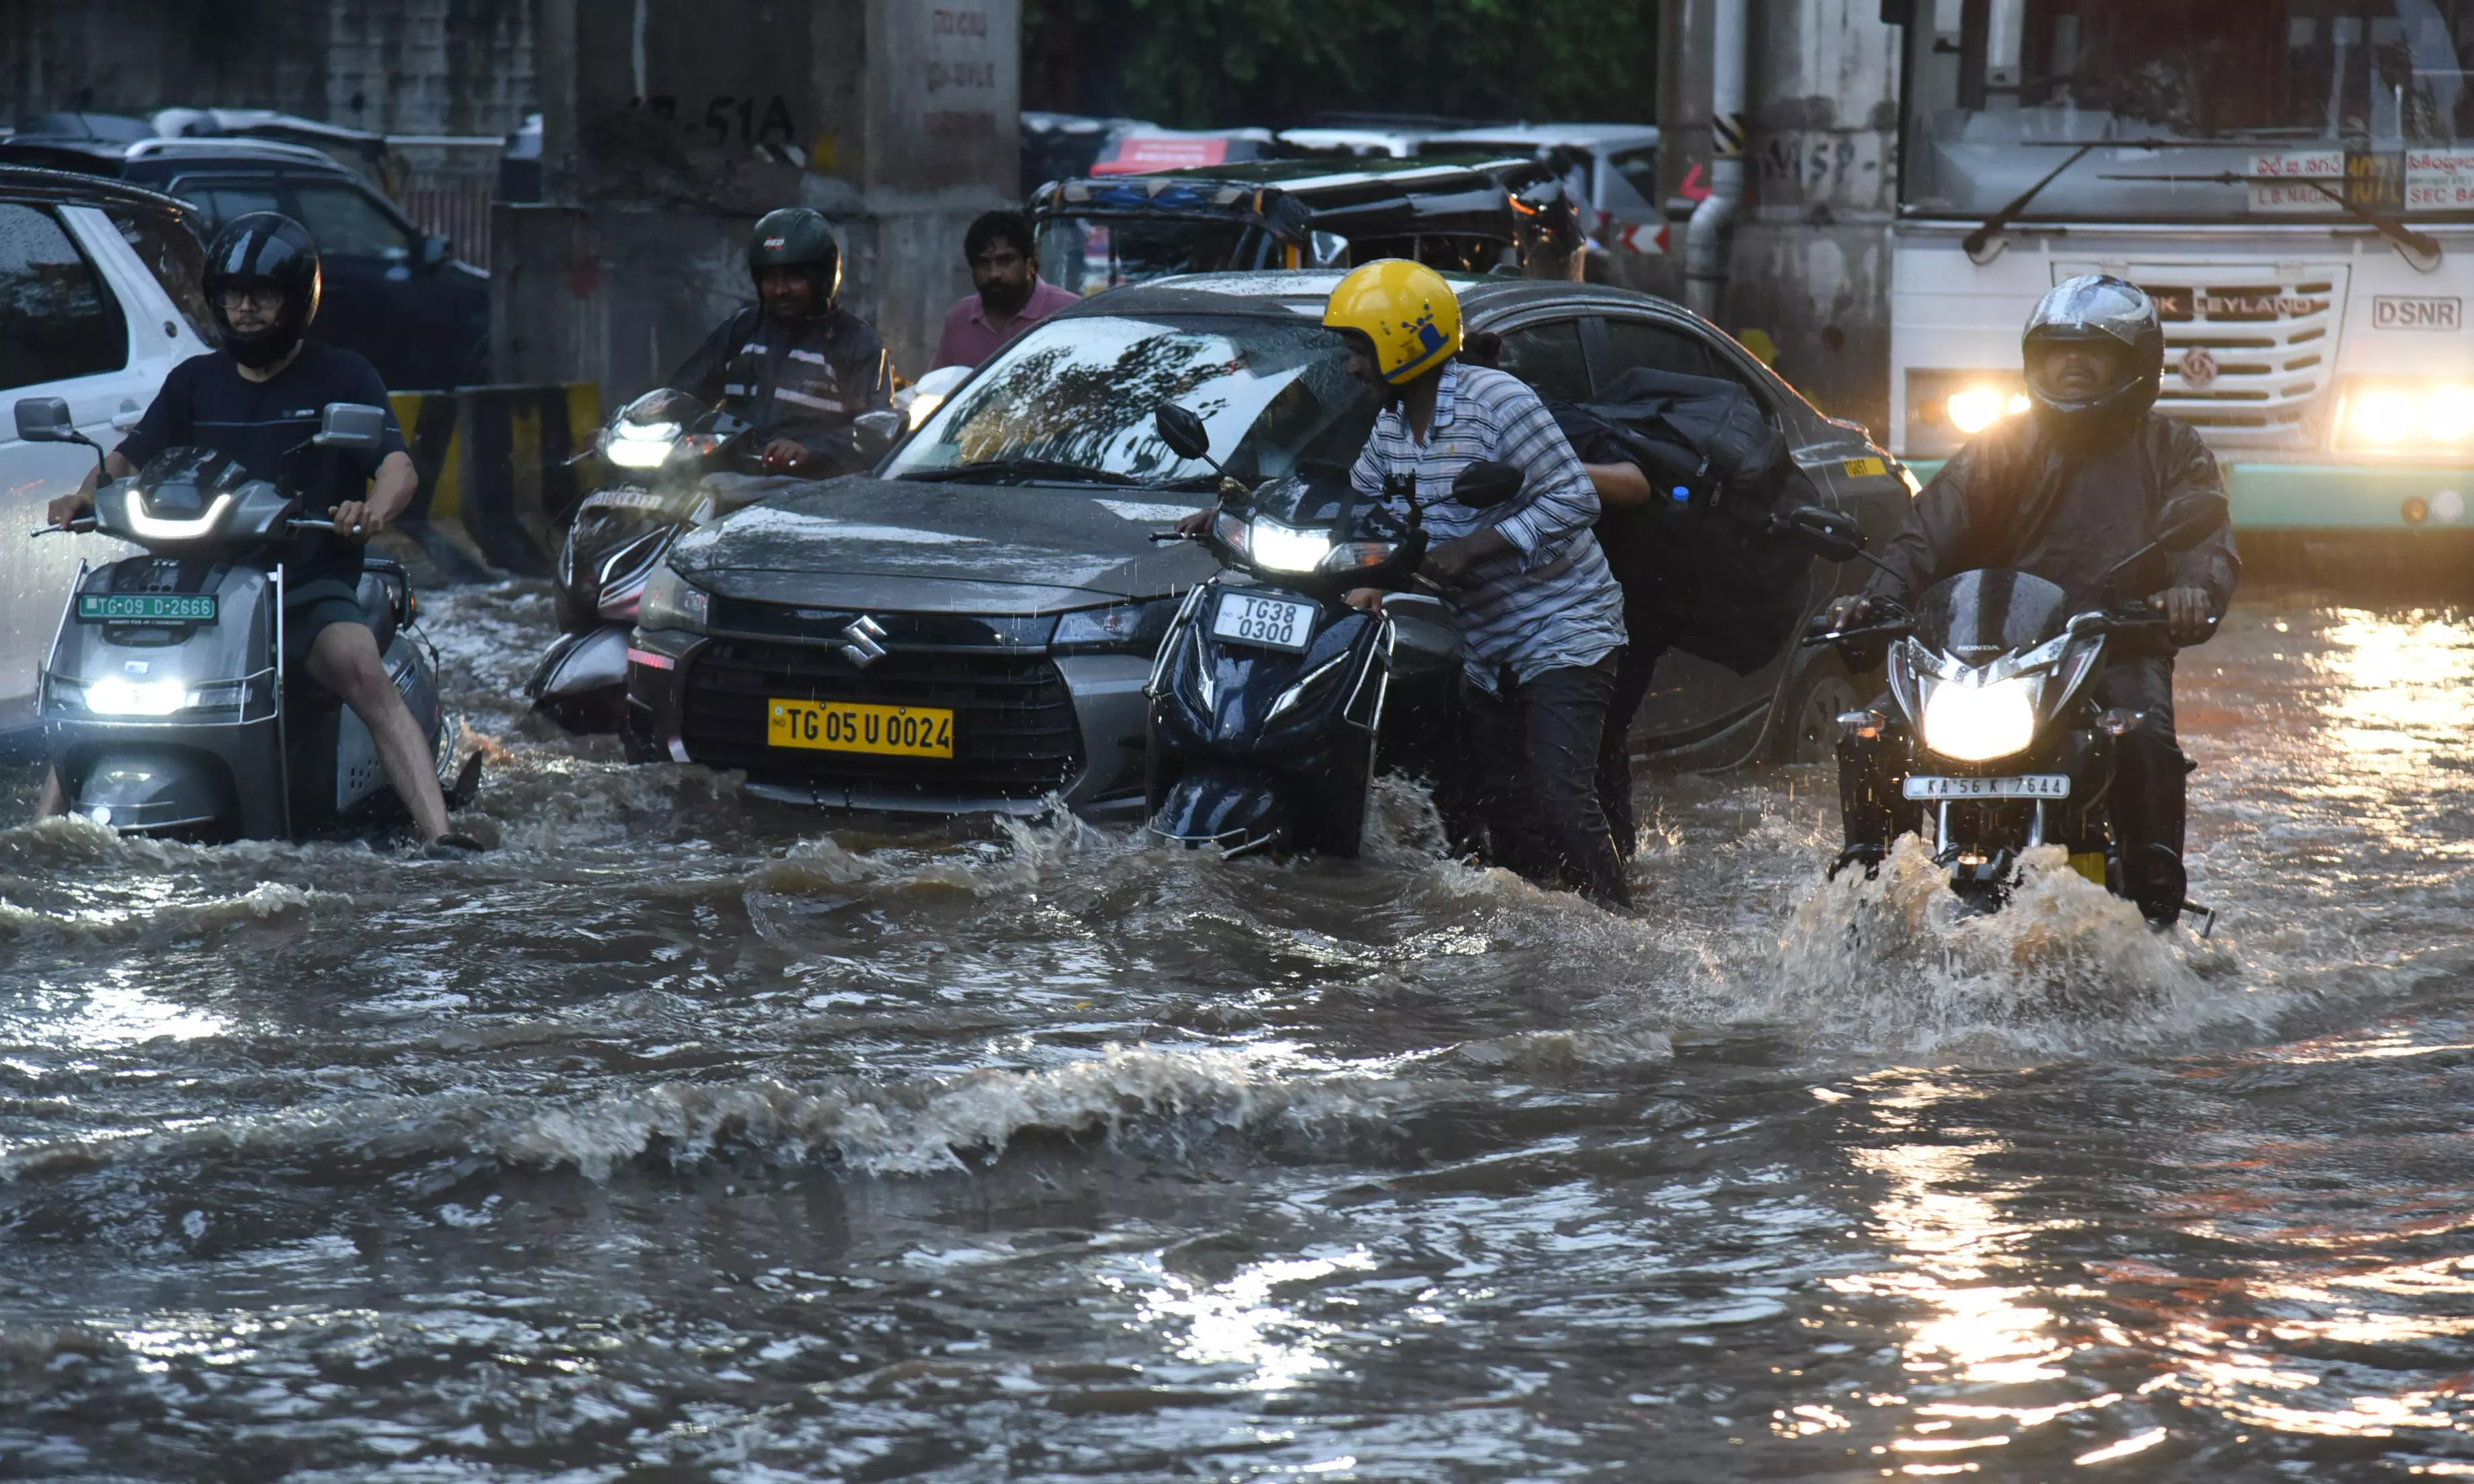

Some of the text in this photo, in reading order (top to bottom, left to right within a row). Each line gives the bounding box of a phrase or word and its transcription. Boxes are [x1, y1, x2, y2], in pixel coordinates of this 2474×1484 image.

[2193, 296, 2313, 314] LEYLAND
[2379, 301, 2454, 325] DSNR
[170, 599, 210, 615] 2666
[1245, 598, 1297, 623] TG38
[1239, 619, 1293, 643] 0300
[787, 708, 950, 749] TG 05 U 0024
[1927, 779, 1948, 793] KA
[1959, 779, 1980, 793] 56
[2013, 777, 2062, 793] 7644
